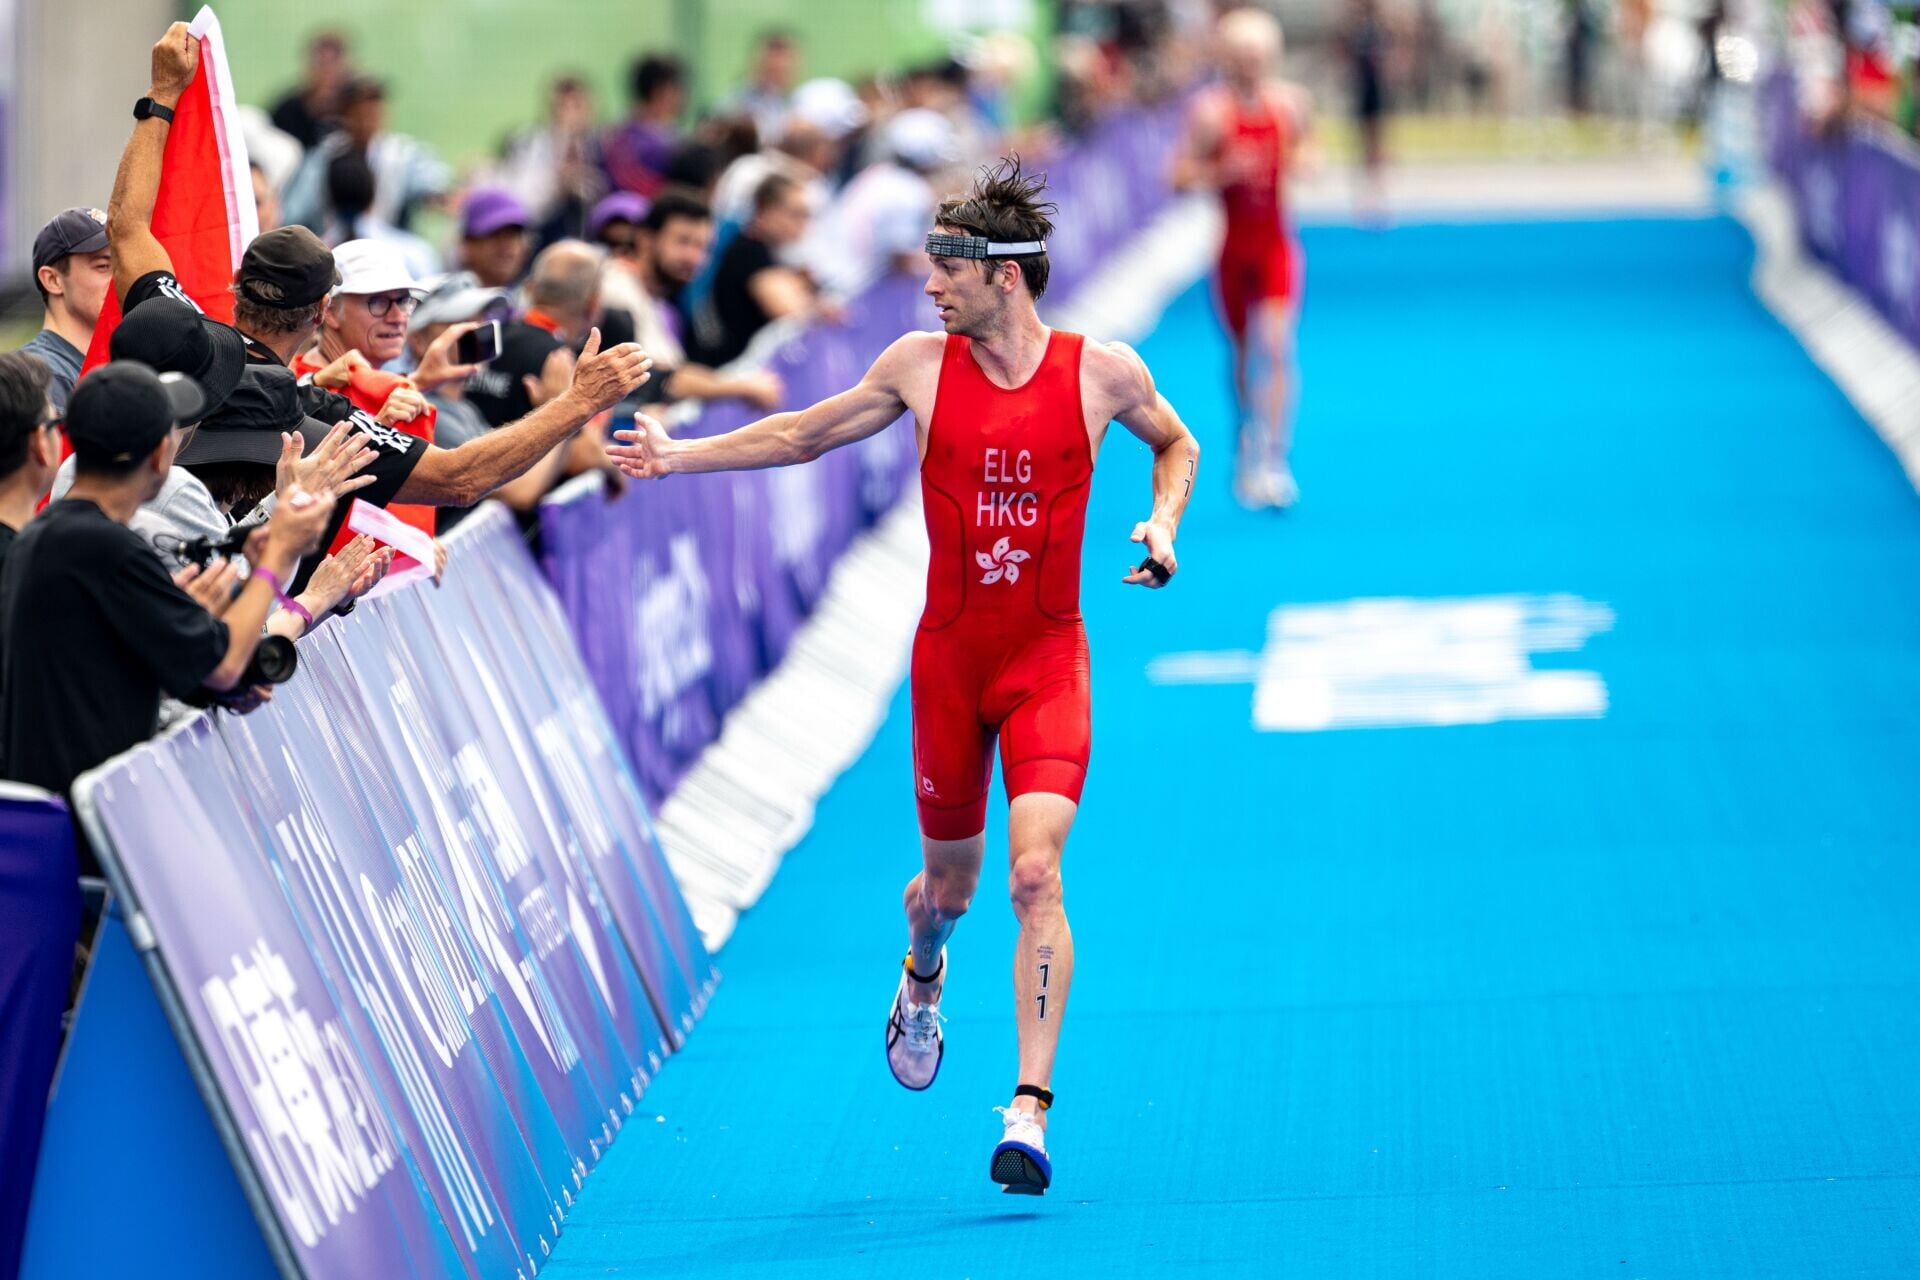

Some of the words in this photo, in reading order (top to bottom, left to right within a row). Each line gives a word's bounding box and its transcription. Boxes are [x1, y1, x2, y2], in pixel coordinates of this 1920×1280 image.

[984, 448, 1032, 484] ELG
[976, 491, 1038, 527] HKG
[1036, 963, 1049, 1019] 11
